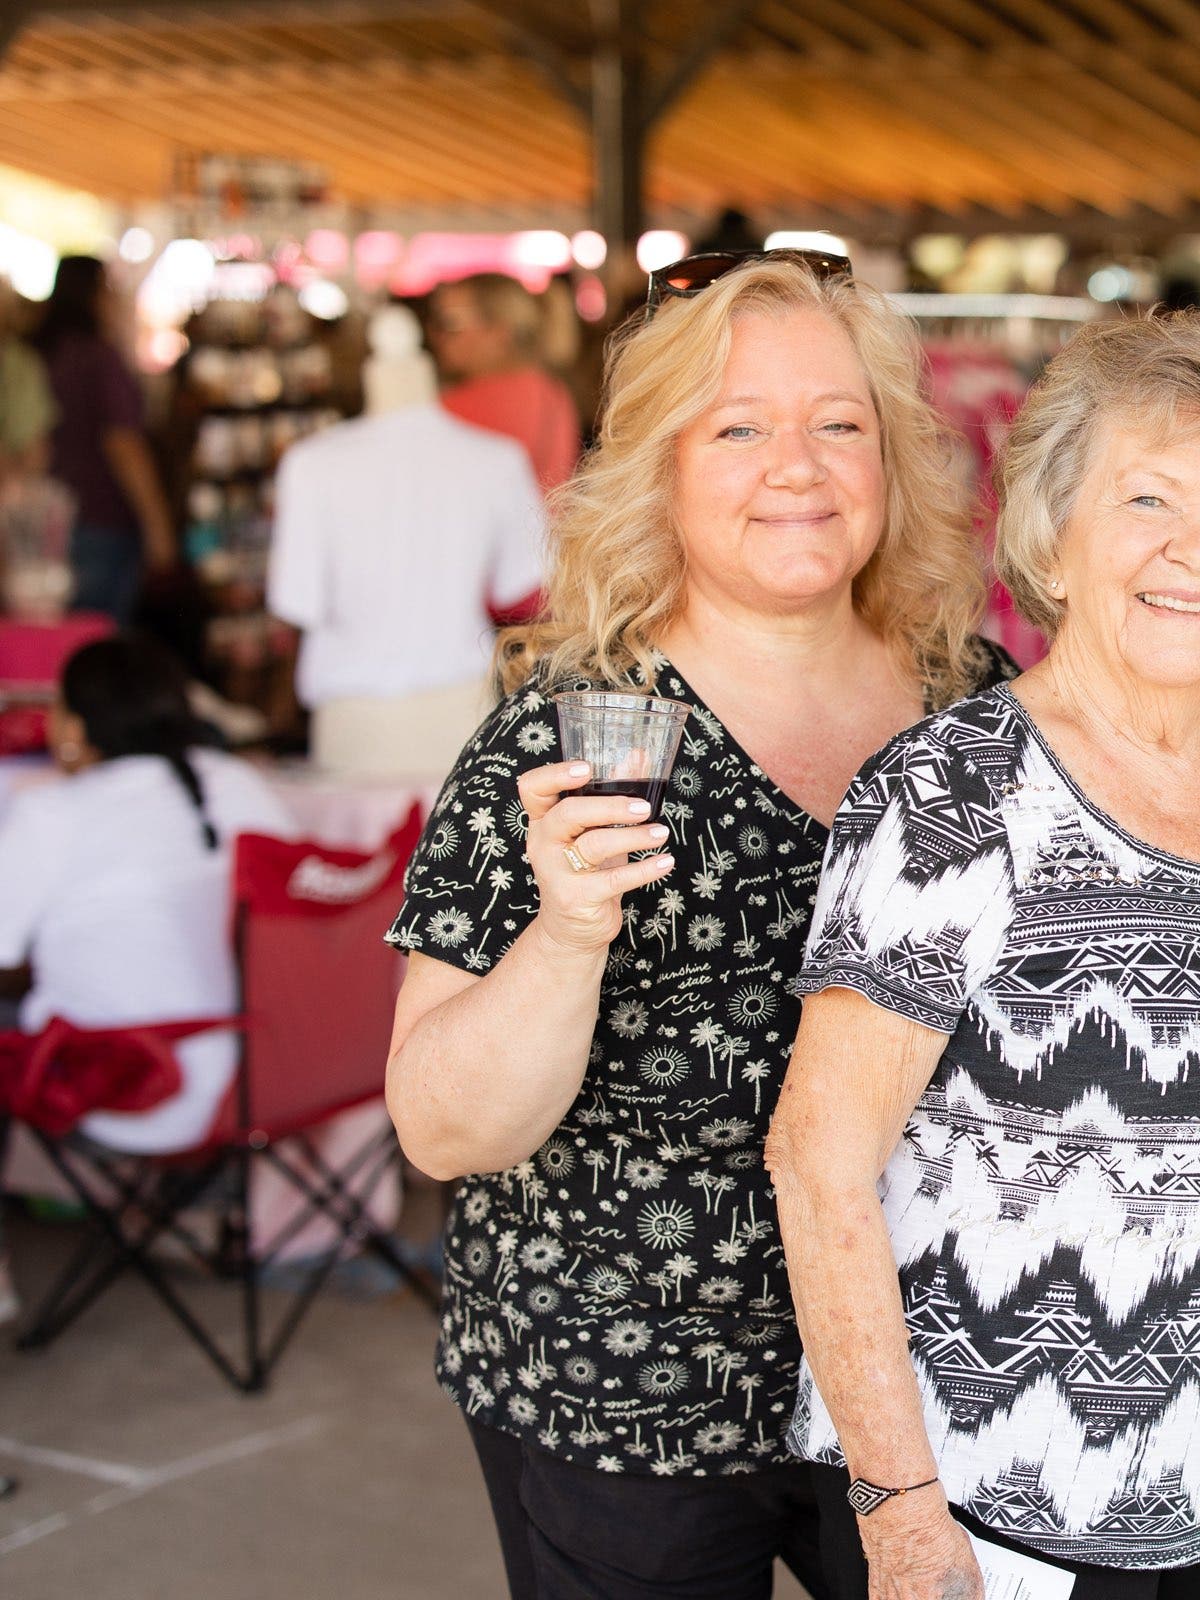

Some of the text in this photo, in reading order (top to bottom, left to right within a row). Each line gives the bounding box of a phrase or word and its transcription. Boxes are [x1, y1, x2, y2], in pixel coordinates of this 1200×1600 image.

[677, 956, 775, 989] state of mind
[608, 1091, 667, 1105] sunshine
